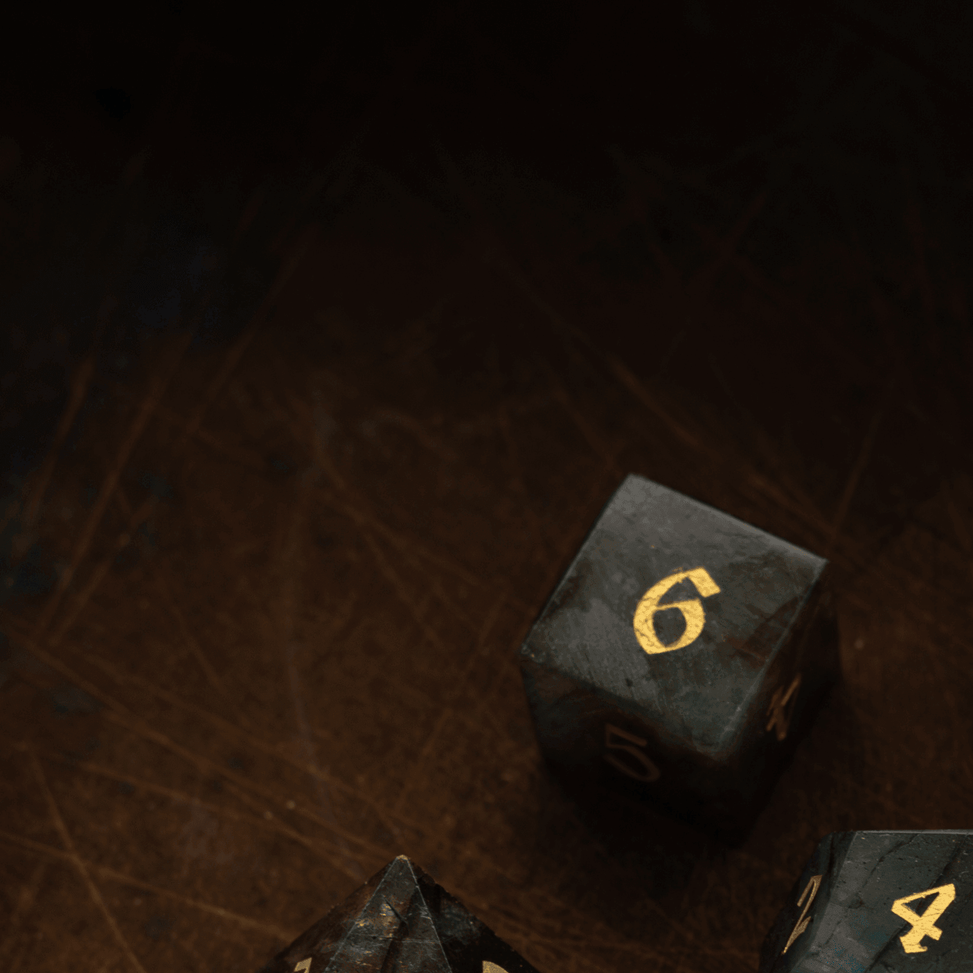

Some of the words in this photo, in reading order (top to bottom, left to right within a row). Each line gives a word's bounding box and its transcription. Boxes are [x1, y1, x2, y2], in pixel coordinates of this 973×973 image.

[632, 567, 722, 655] 6
[603, 722, 661, 783] 5
[781, 874, 823, 955] 2
[891, 882, 956, 954] 4
